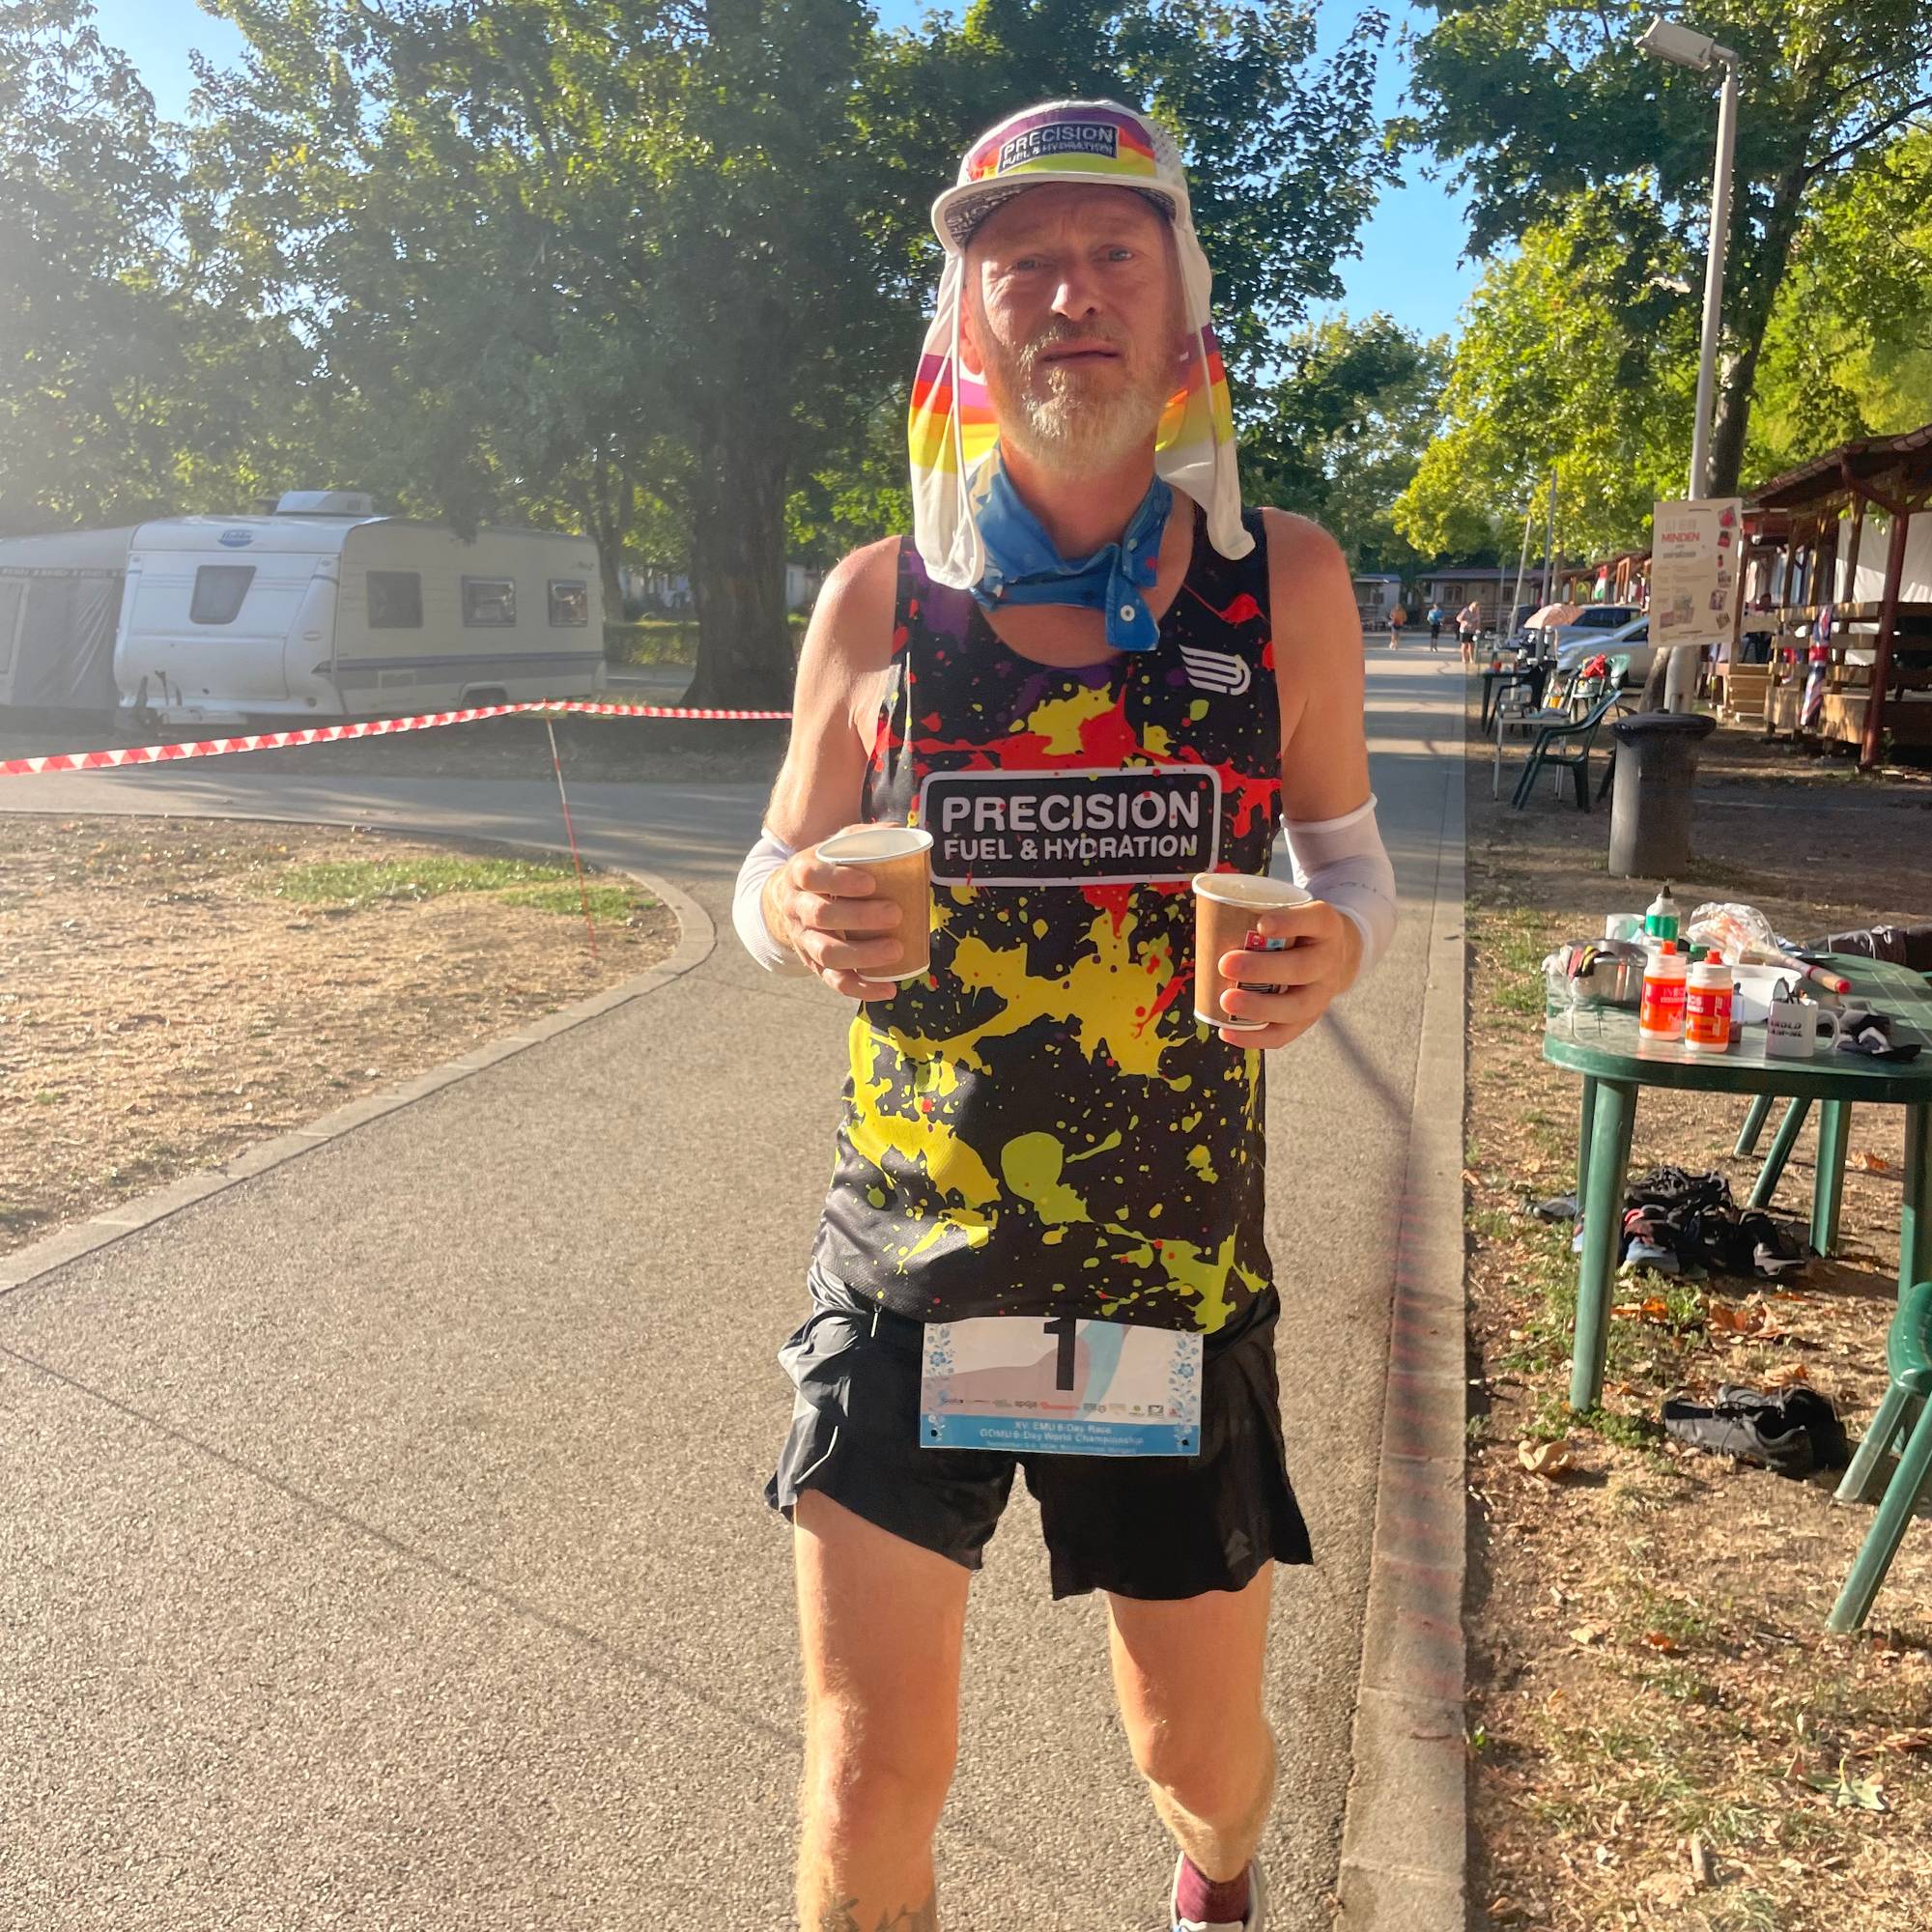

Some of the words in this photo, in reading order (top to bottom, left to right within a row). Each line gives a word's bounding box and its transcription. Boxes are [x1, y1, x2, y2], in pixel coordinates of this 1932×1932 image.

[1004, 126, 1113, 160] PRECISION
[1662, 532, 1700, 543] MINDEN
[942, 790, 1200, 833] PRECISION
[944, 838, 1013, 862] FUEL
[1020, 838, 1038, 862] &
[1044, 834, 1198, 861] HYDRATION
[1043, 1317, 1077, 1391] 1
